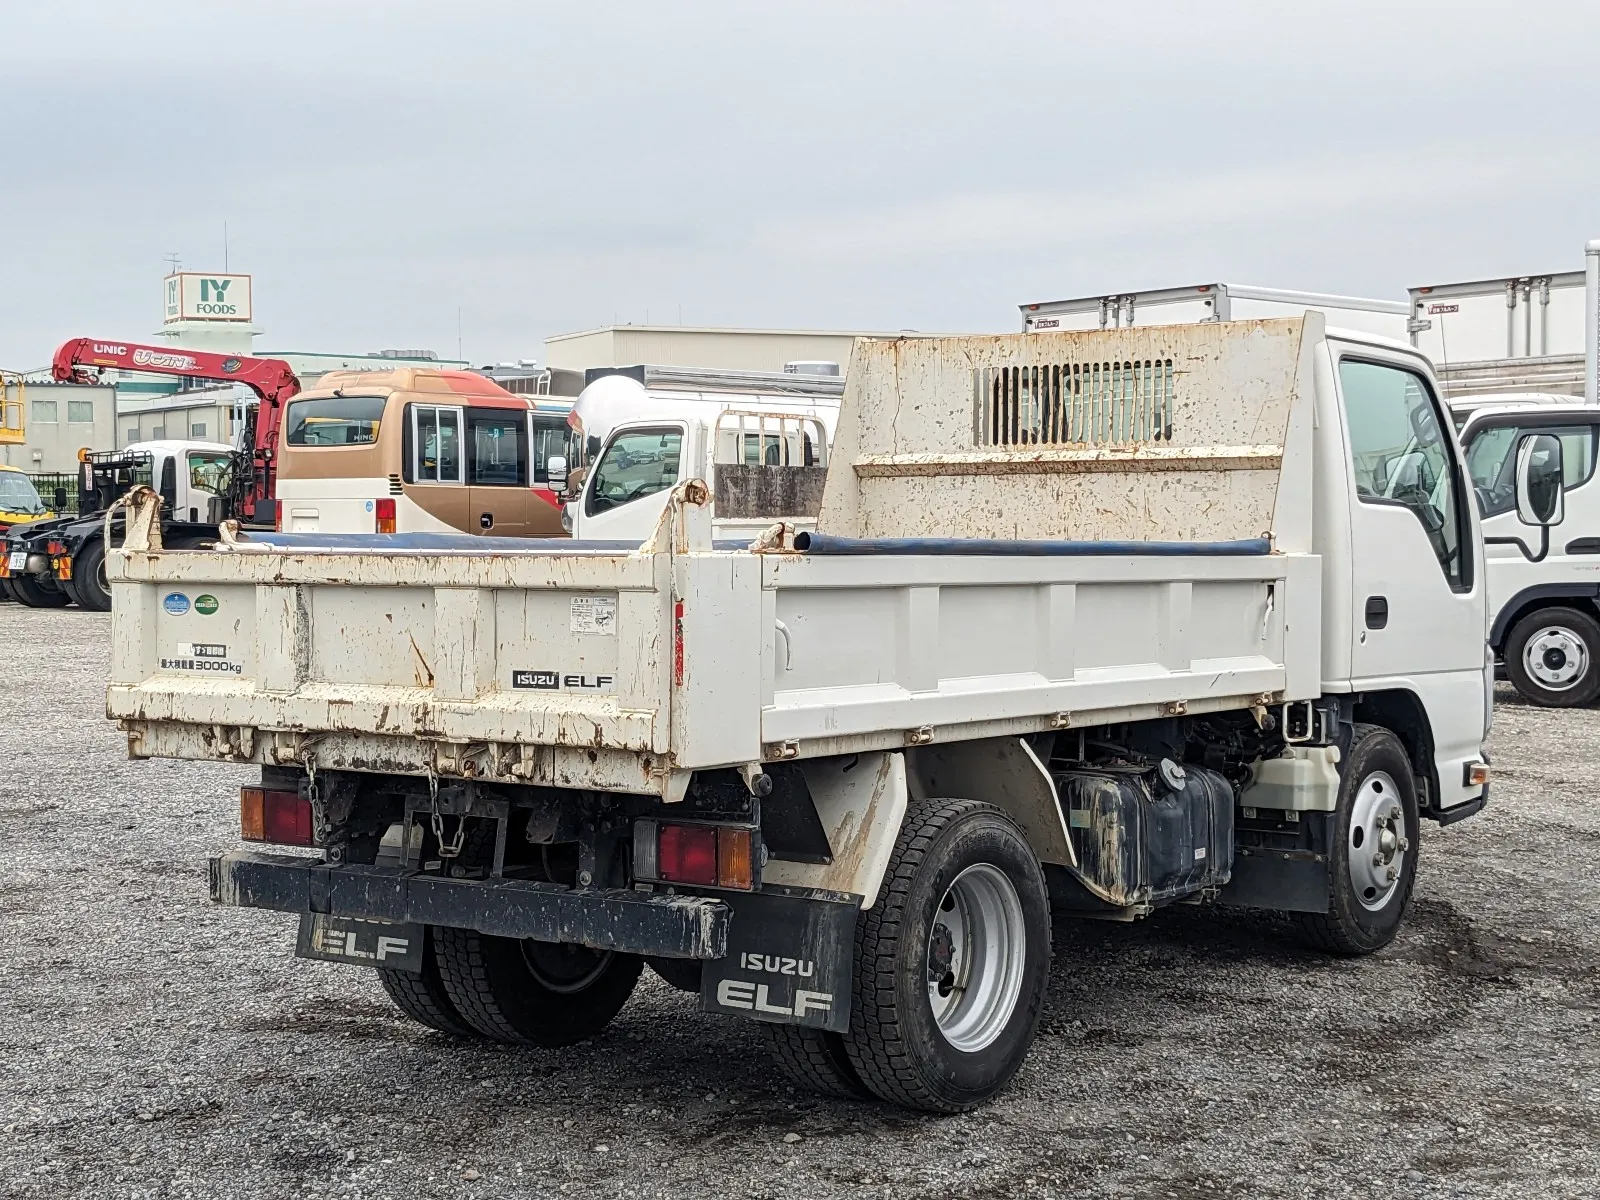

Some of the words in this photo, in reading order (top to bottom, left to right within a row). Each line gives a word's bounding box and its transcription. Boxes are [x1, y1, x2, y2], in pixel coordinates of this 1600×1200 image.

[200, 279, 232, 302] IY
[196, 303, 236, 315] FOODS
[93, 343, 128, 356] UNIC
[353, 434, 375, 442] HINO
[517, 674, 555, 685] ISUZU
[563, 675, 613, 688] ELF
[313, 928, 409, 961] ELF
[740, 952, 814, 977] ISUZU
[716, 979, 833, 1017] ELF
